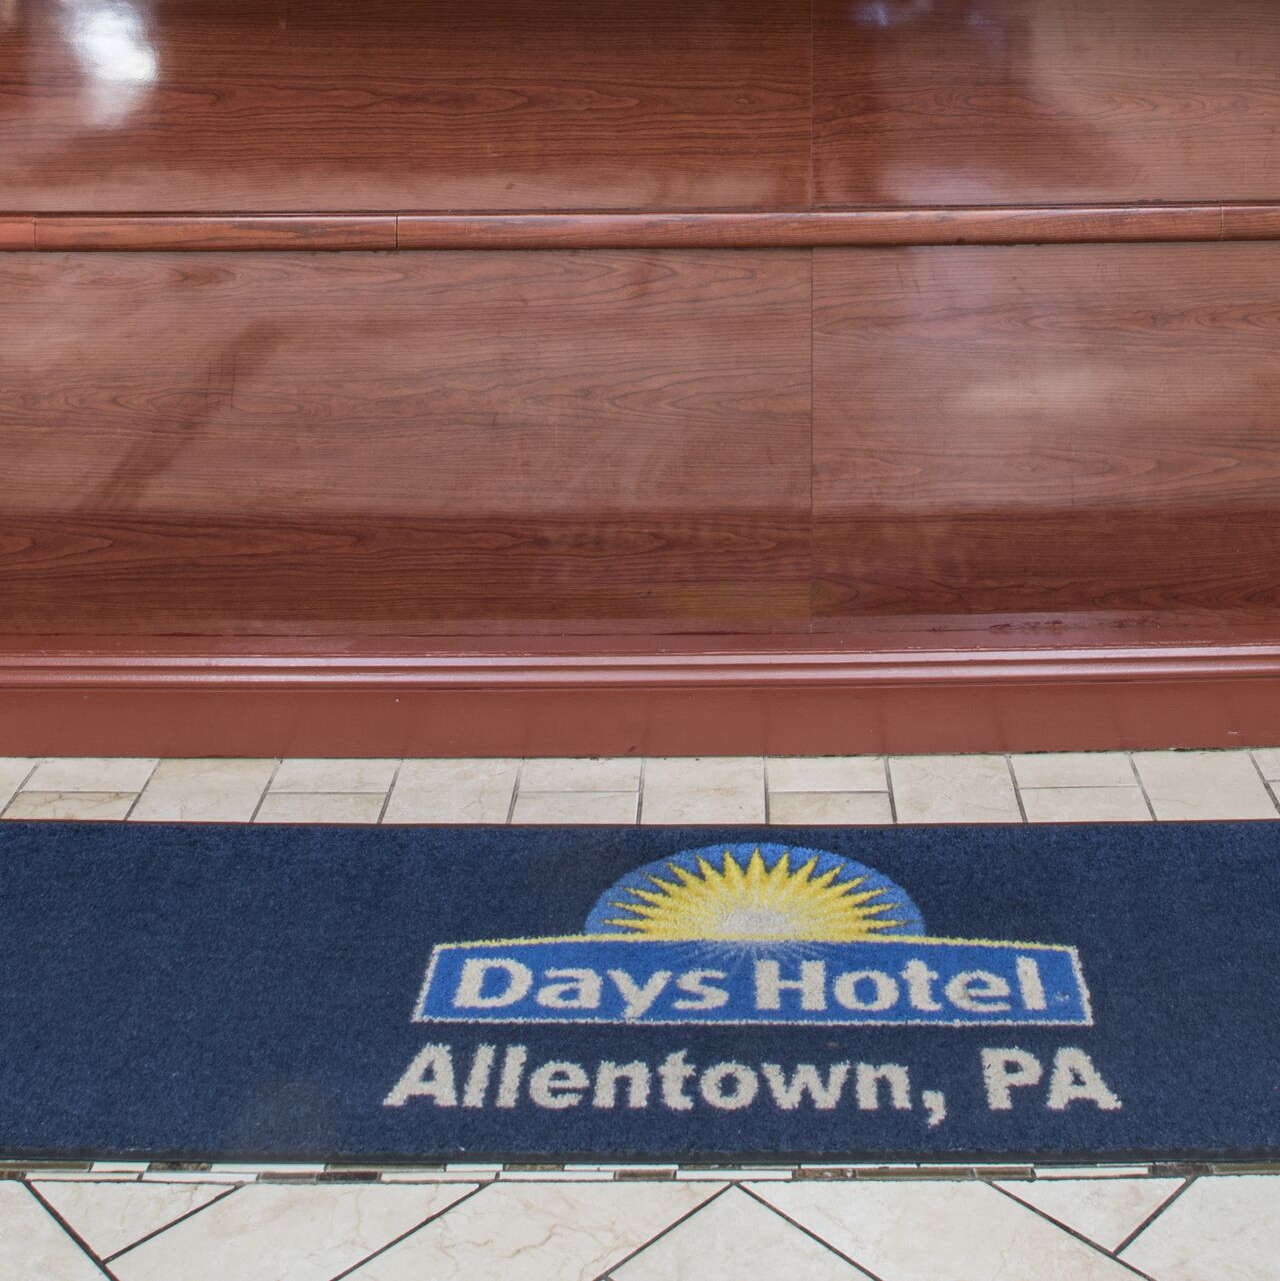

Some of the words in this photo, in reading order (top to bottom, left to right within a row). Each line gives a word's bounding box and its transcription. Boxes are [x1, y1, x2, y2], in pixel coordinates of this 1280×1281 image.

[453, 958, 730, 1018] Days
[753, 956, 1048, 1012] Hotel
[382, 1042, 947, 1127] Allentown,
[980, 1046, 1123, 1112] PA
